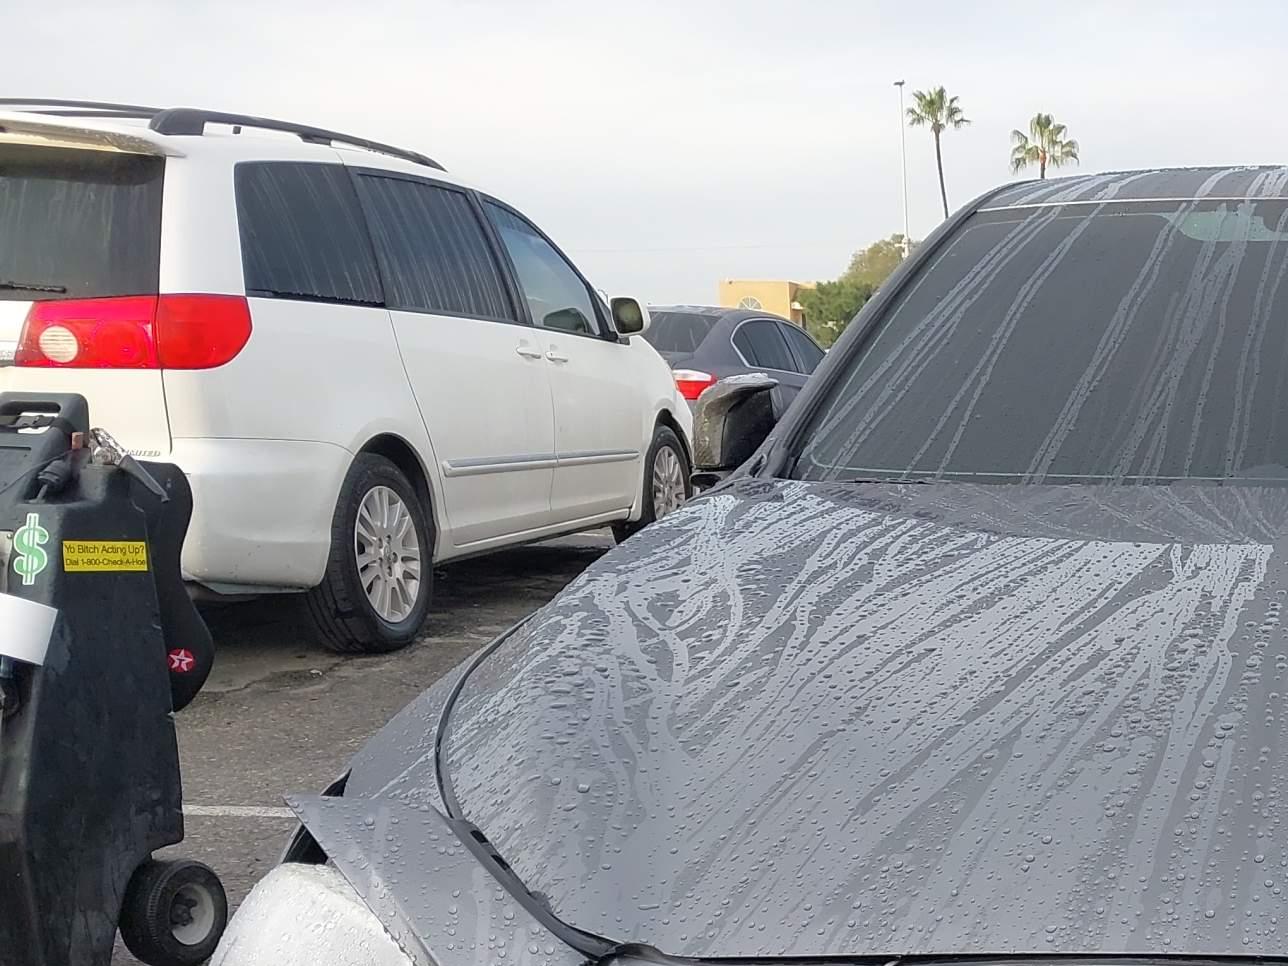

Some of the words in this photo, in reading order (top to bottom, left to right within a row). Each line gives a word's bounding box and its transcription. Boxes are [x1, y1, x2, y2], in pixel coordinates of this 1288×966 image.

[65, 544, 76, 554] Yo
[77, 544, 99, 554] Bitch
[101, 545, 127, 556] Acting
[128, 545, 145, 556] Up?
[65, 558, 79, 566] Dial
